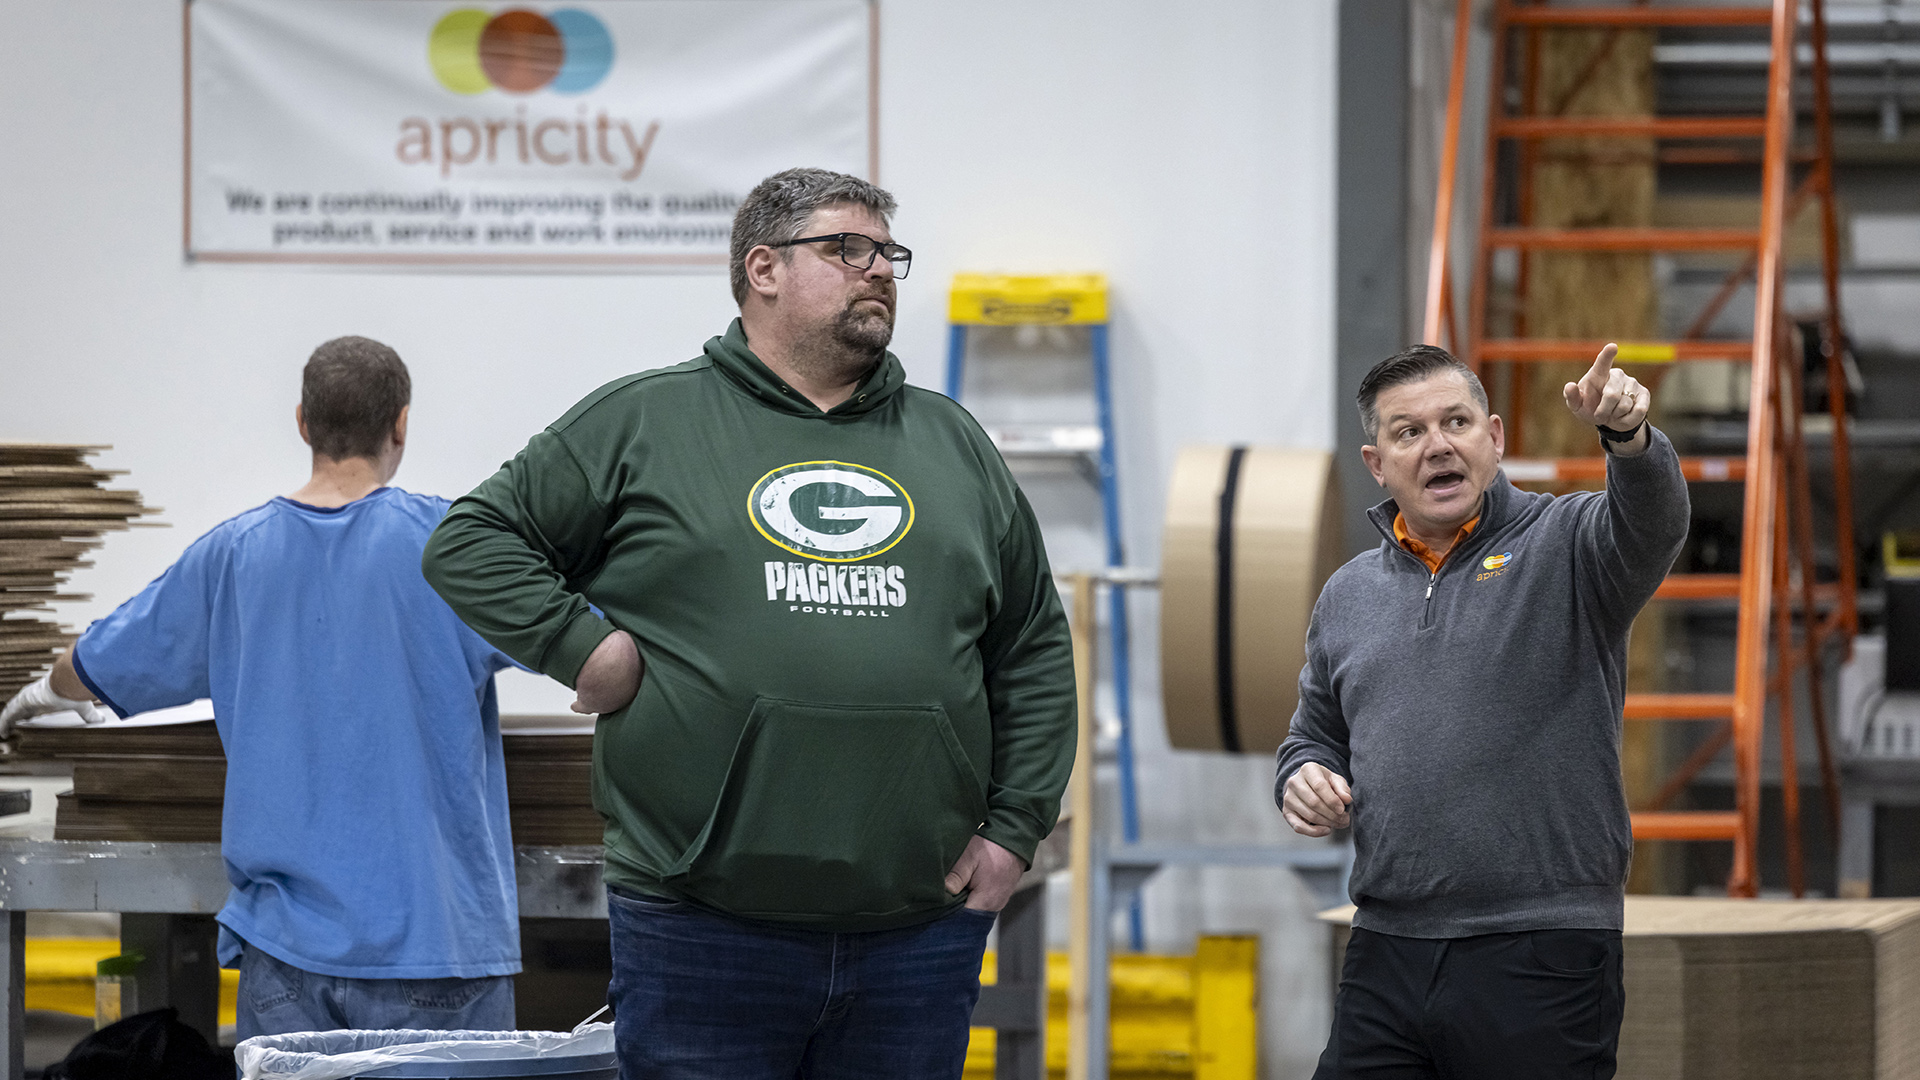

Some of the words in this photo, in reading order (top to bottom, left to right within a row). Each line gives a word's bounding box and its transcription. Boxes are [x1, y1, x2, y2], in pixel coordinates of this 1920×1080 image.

[396, 104, 660, 181] apricity
[226, 188, 264, 213] We
[271, 193, 310, 214] are
[317, 189, 464, 219] continually
[470, 192, 604, 222] improving
[611, 189, 652, 214] the
[388, 221, 479, 244] service
[486, 219, 534, 243] and
[542, 220, 604, 244] work
[760, 469, 902, 552] G
[764, 561, 907, 607] PACKERS
[790, 605, 890, 617] FOOTBALL
